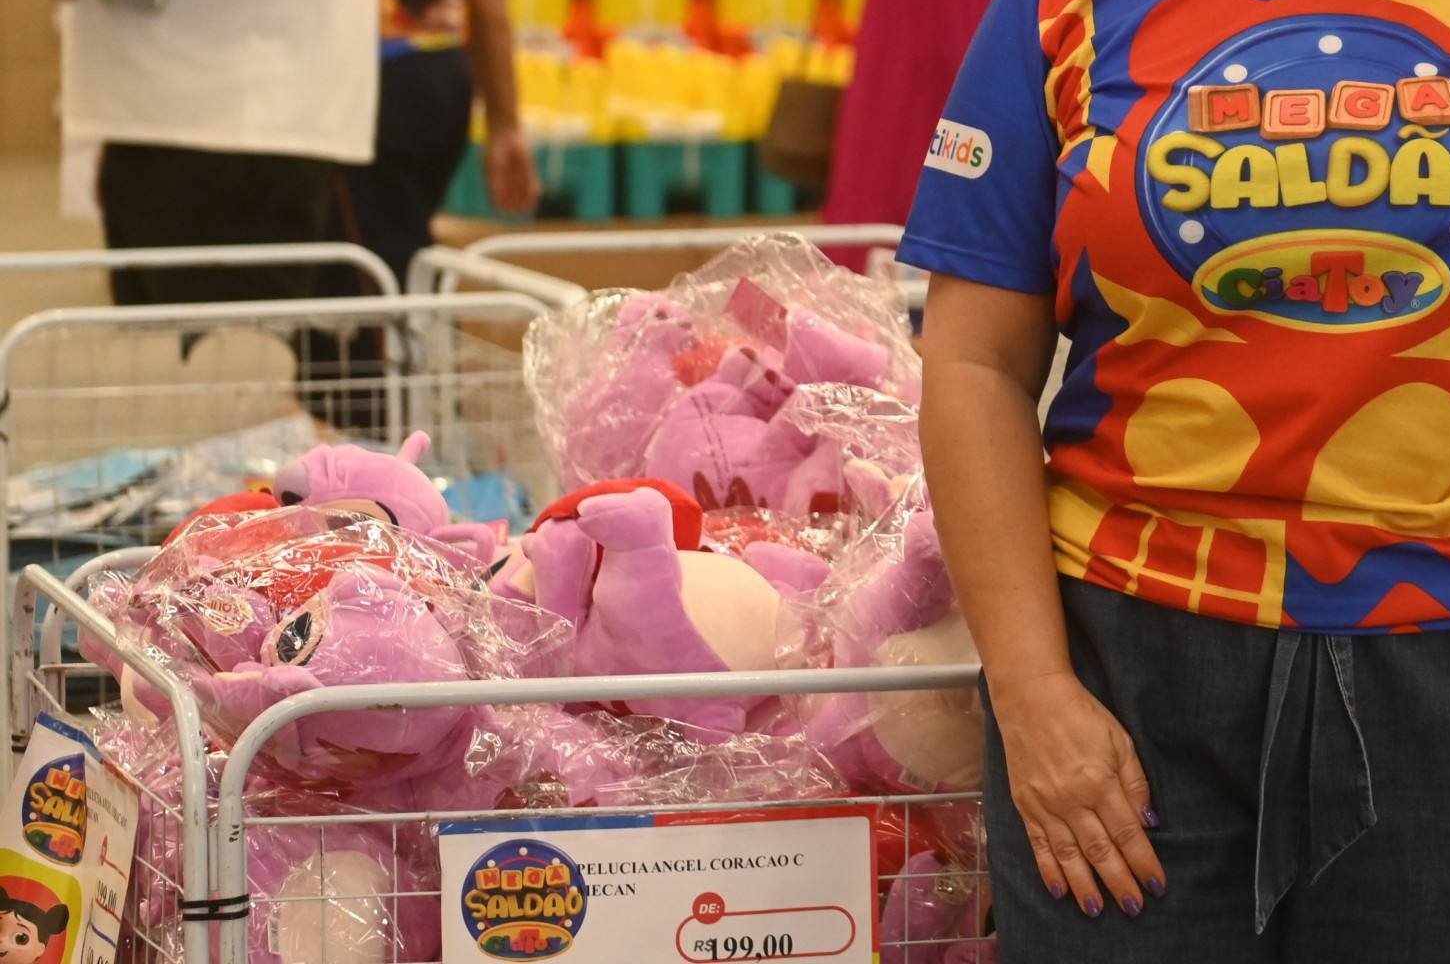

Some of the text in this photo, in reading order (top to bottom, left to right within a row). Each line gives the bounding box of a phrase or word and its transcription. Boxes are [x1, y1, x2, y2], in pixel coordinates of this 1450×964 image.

[1209, 82, 1450, 127] MEGA
[1217, 250, 1424, 313] CiaToy
[481, 866, 565, 887] MEGA
[577, 853, 805, 876] PELUCIA ANGEL CORACAO C
[699, 903, 720, 914] DE:
[694, 933, 794, 963] R$ 199,00
